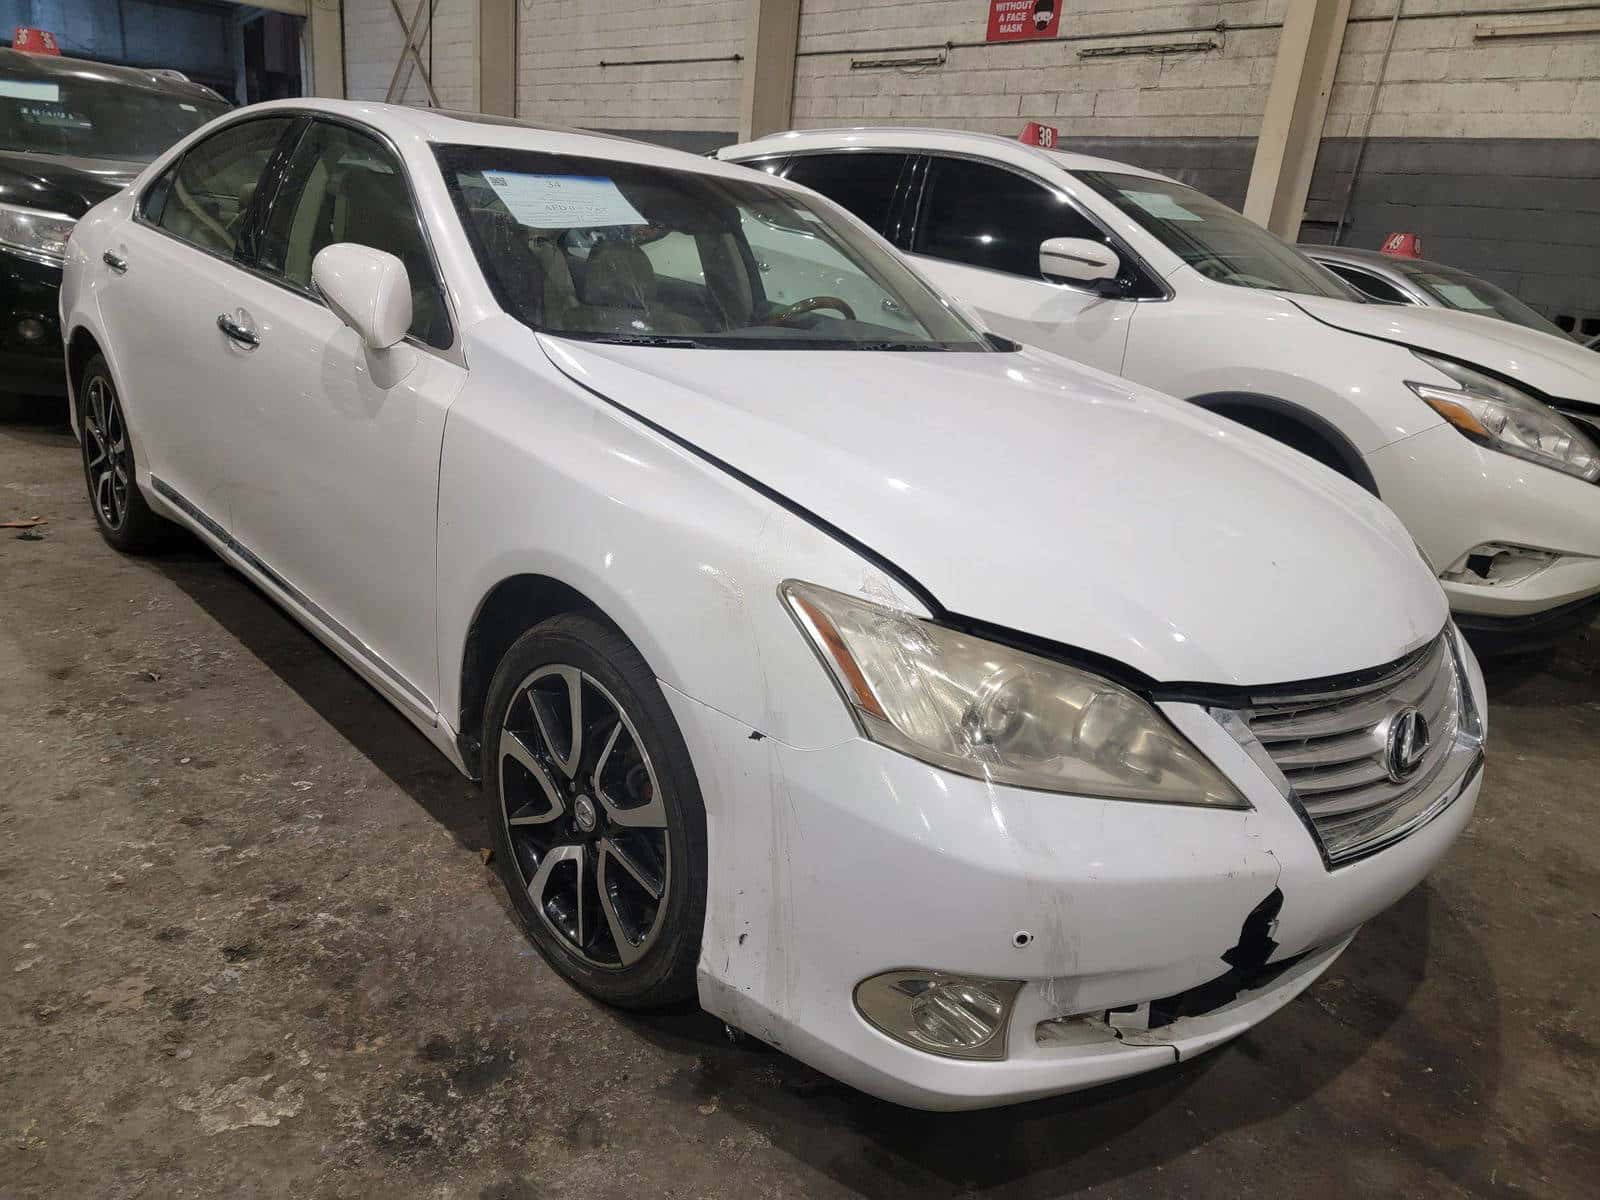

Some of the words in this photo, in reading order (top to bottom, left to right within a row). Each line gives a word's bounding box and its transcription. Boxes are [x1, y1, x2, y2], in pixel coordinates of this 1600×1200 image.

[996, 1, 1033, 11] WITHOUT
[999, 14, 1004, 22] A
[1006, 12, 1027, 21] FACE
[1000, 24, 1022, 33] MASK
[1039, 126, 1052, 147] 38
